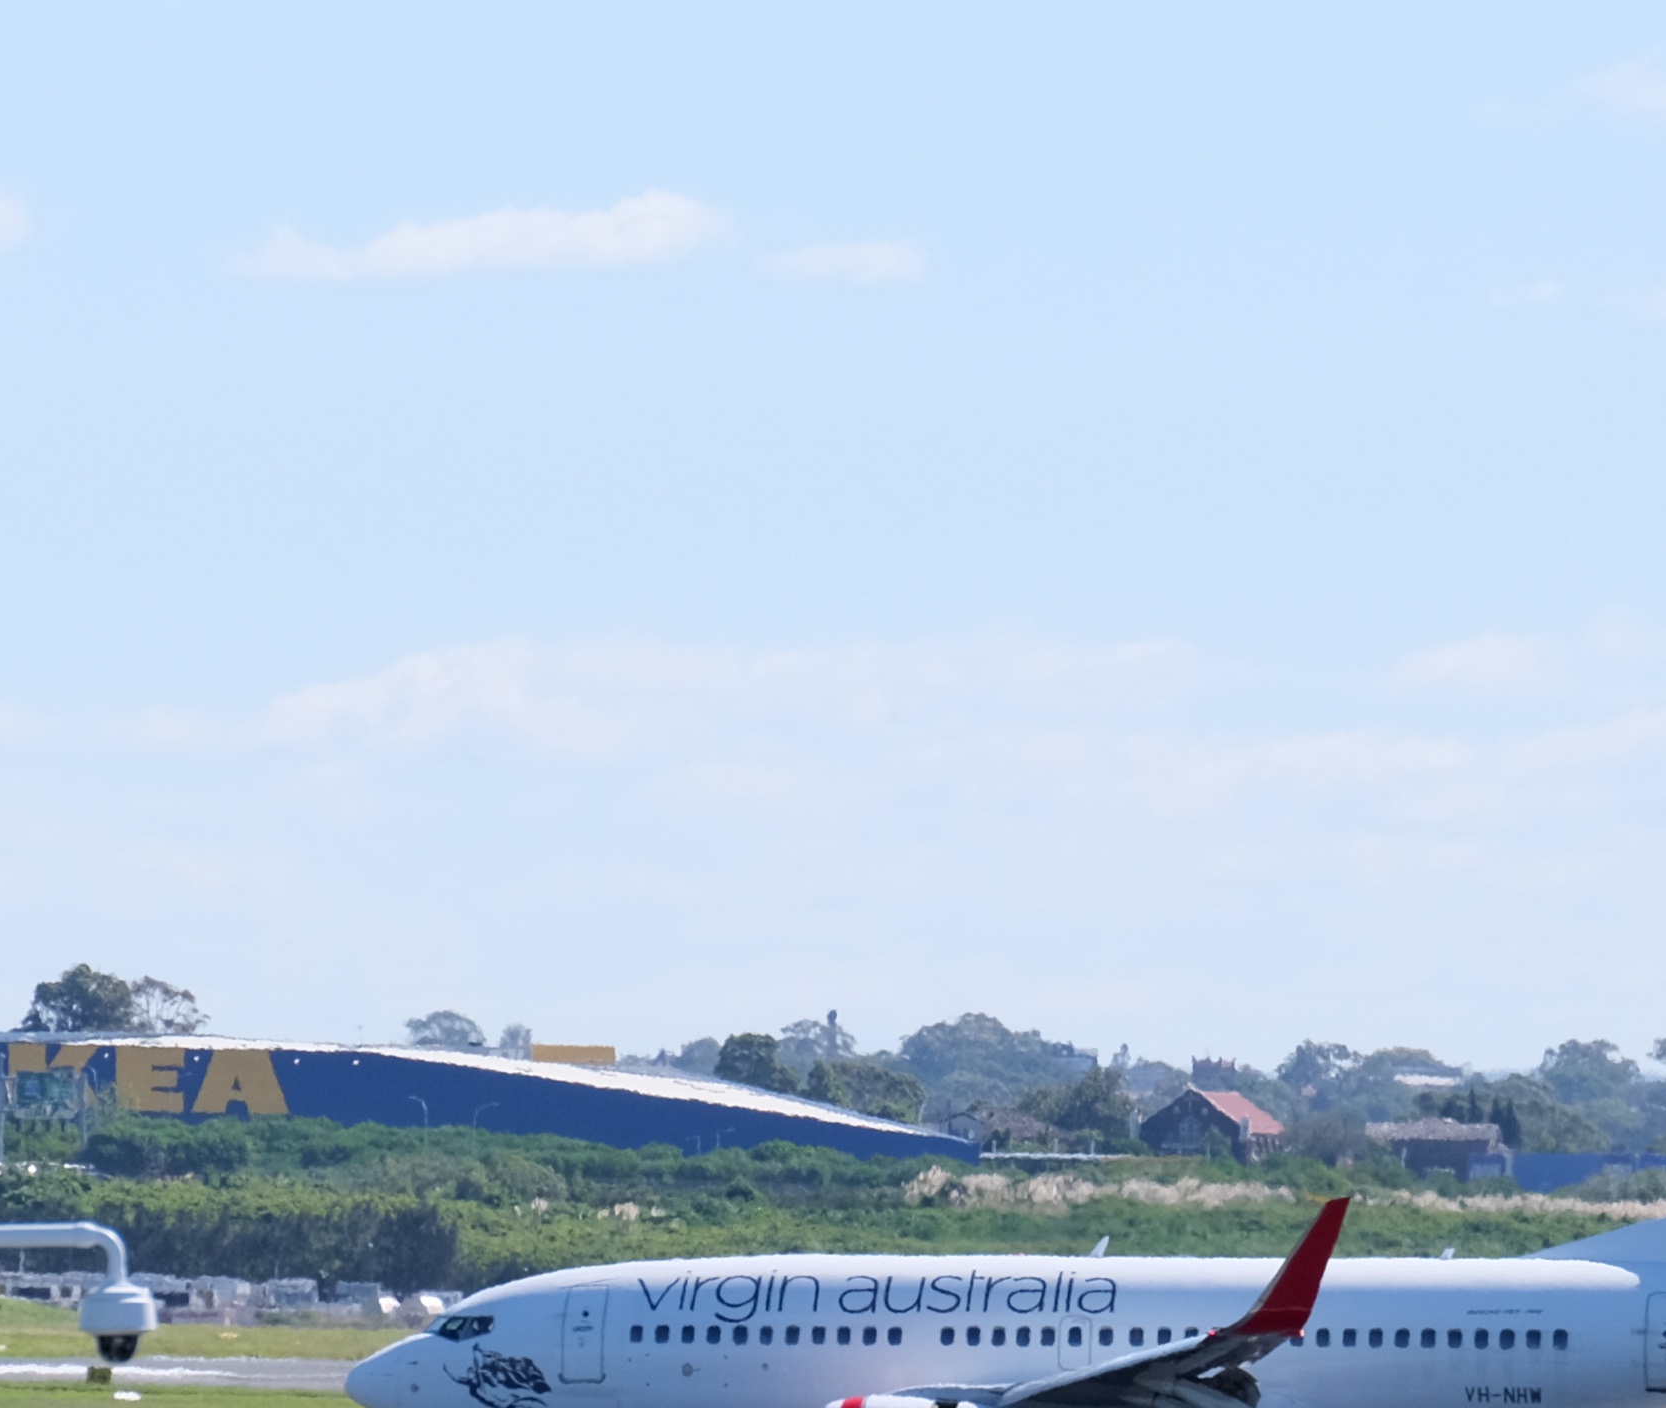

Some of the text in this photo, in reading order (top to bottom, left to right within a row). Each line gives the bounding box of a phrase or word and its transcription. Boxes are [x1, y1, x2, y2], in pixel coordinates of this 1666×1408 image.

[636, 1268, 1118, 1324] virgin australia
[1465, 1386, 1542, 1403] VH-NHW
